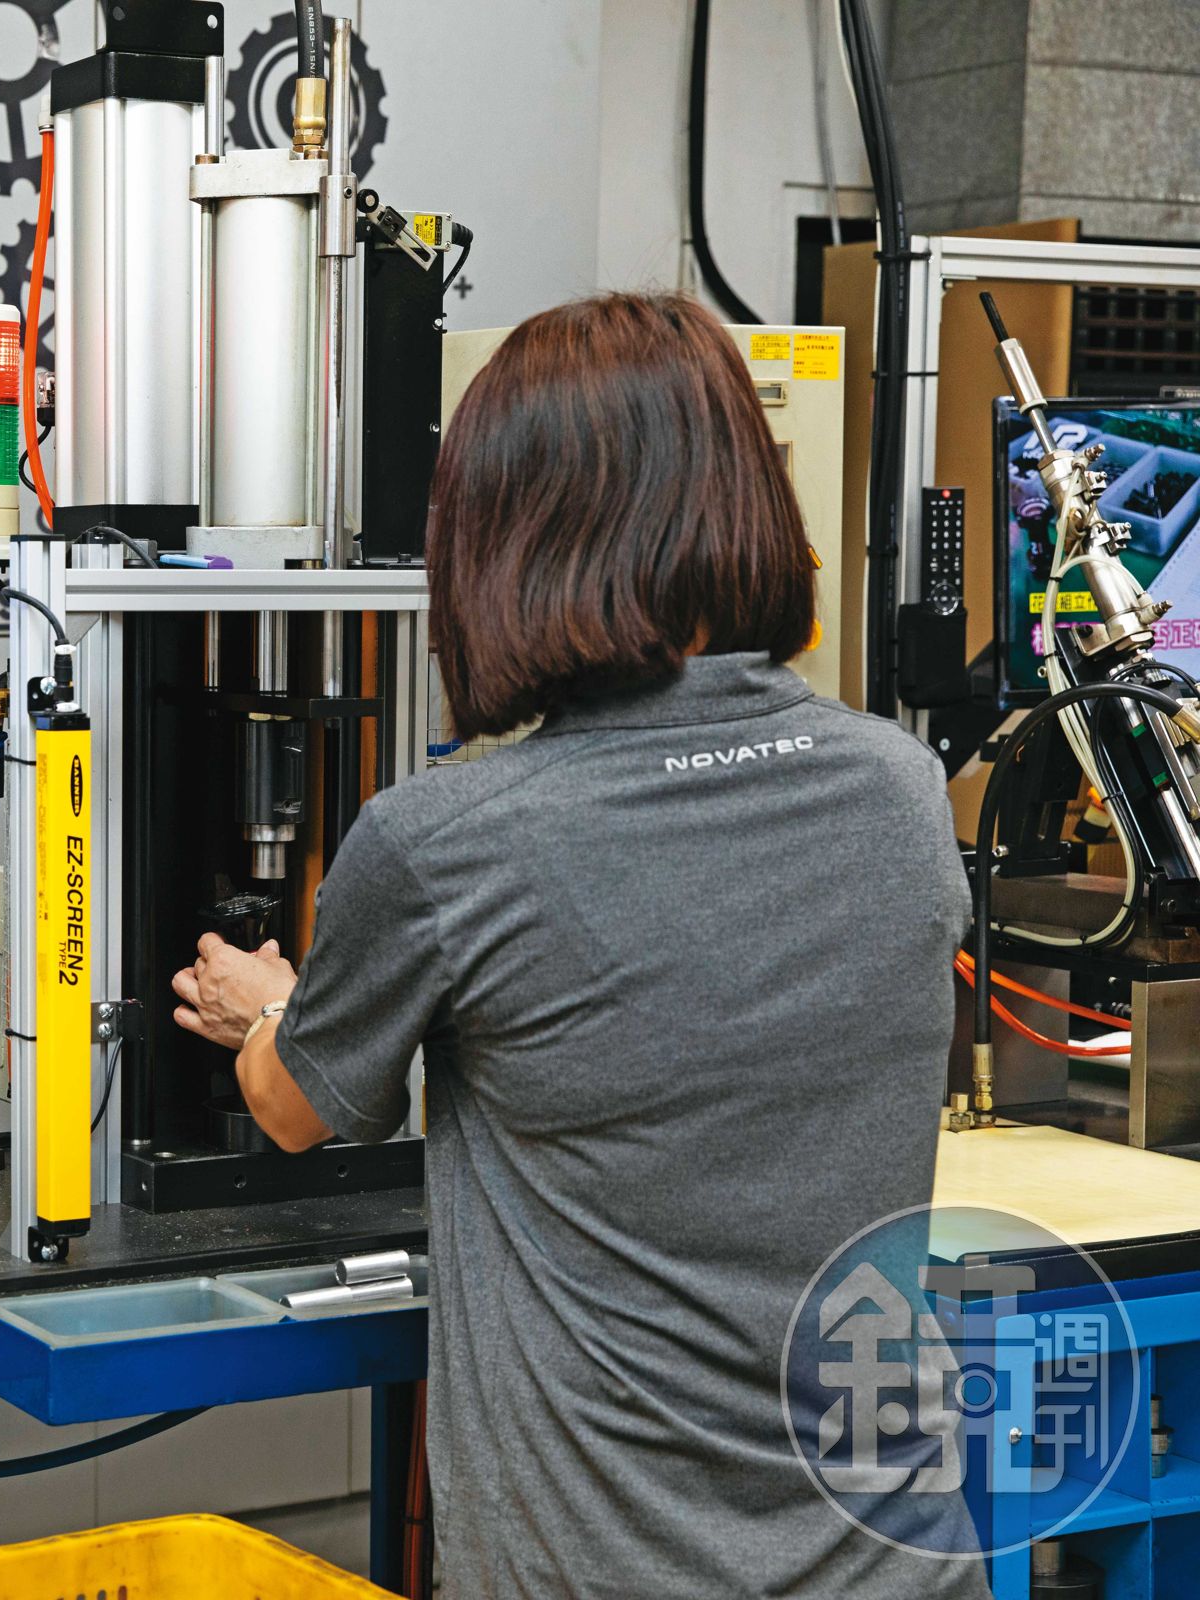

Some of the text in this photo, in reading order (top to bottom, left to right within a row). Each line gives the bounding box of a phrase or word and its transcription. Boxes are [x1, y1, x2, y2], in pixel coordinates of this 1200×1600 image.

[664, 735, 814, 773] NOVATEC
[72, 757, 81, 816] BANNER
[66, 835, 84, 971] EZ-SCREEN
[58, 941, 79, 986] TYPE 2
